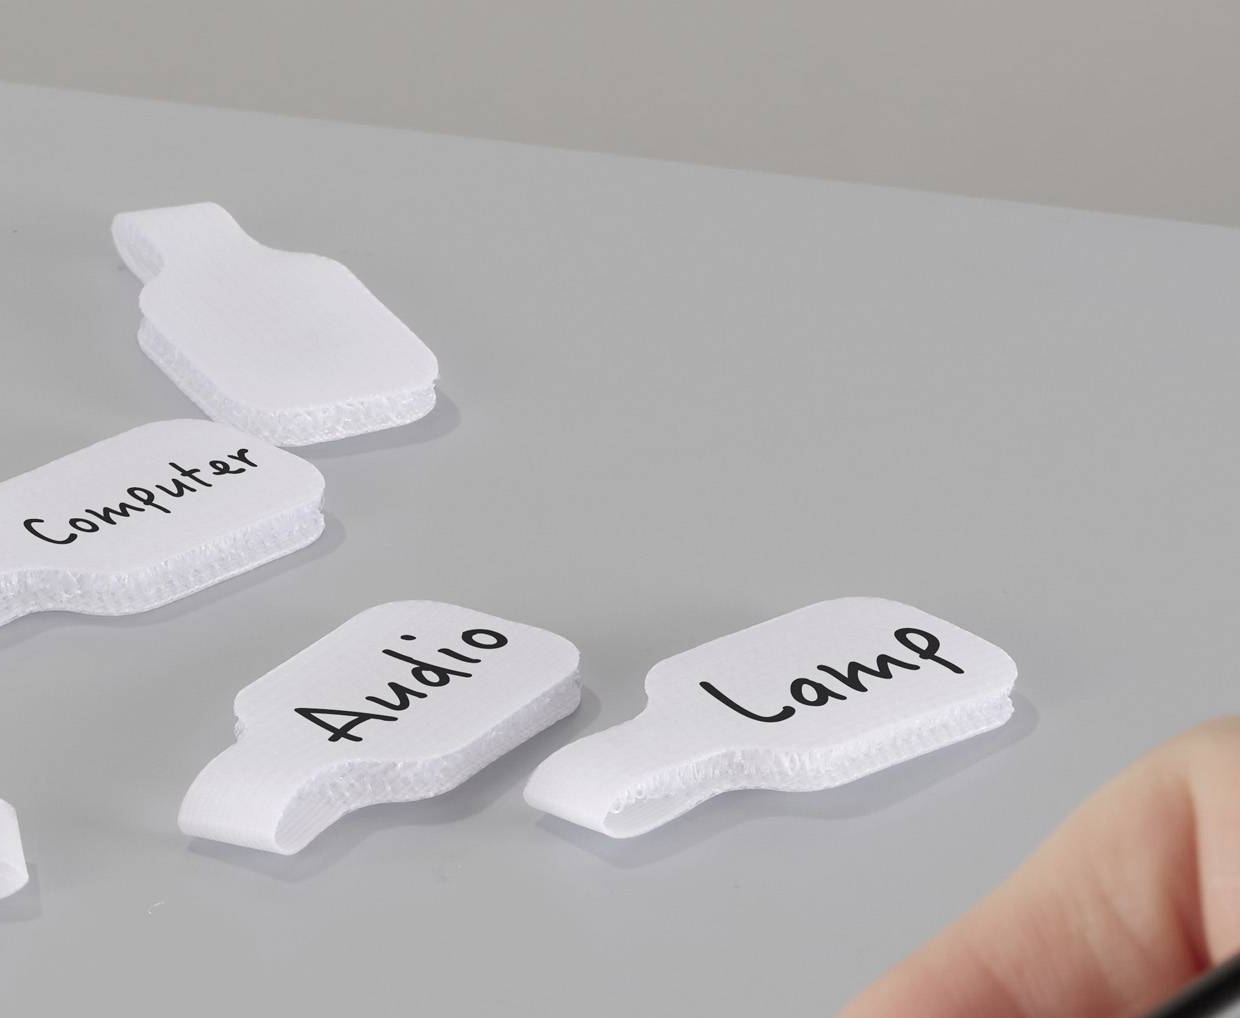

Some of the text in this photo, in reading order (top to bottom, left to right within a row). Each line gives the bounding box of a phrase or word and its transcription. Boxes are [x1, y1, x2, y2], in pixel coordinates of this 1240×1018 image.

[23, 448, 258, 545] Computer
[294, 627, 510, 744] Audio
[699, 626, 966, 724] Lamp
